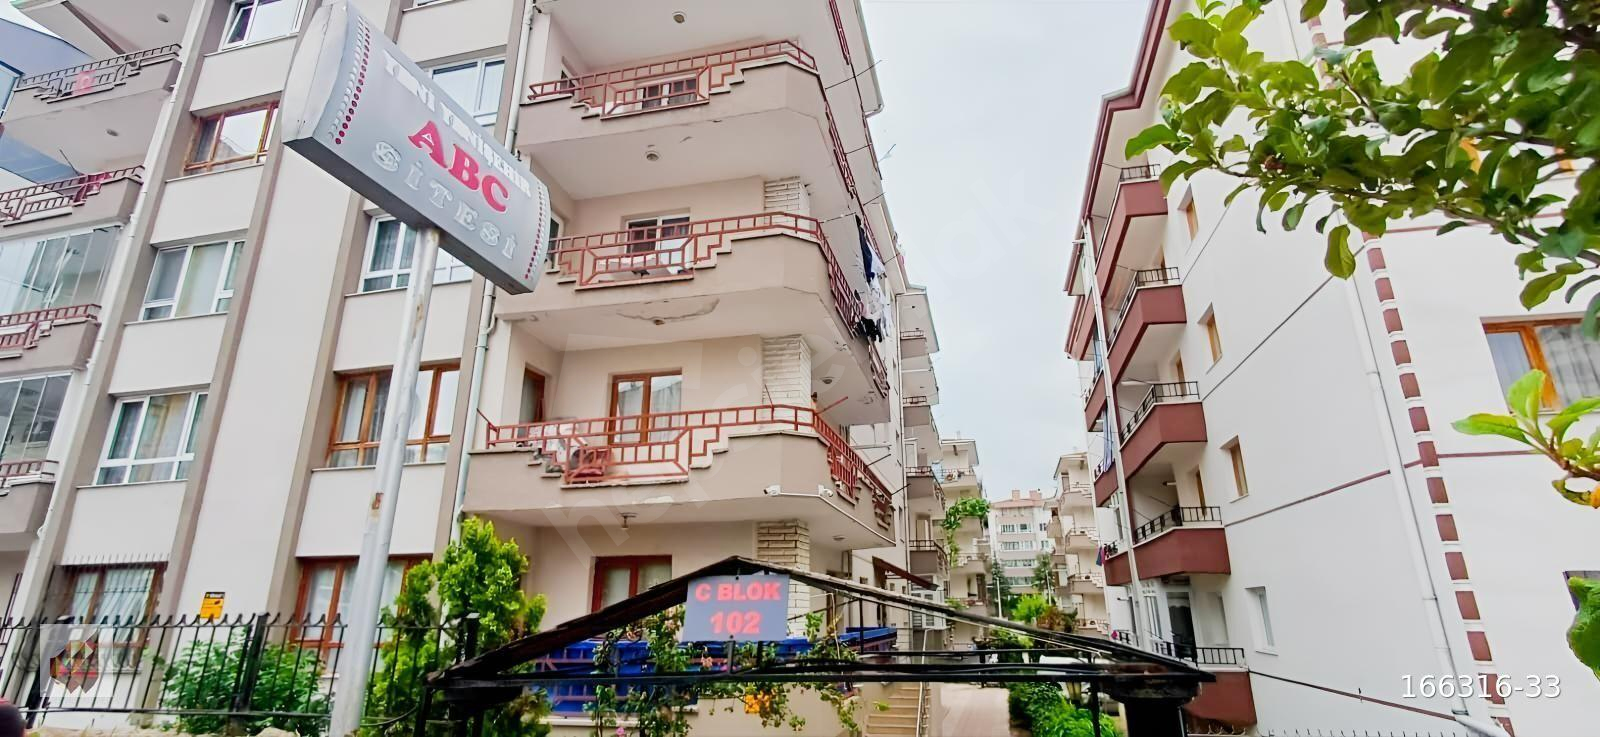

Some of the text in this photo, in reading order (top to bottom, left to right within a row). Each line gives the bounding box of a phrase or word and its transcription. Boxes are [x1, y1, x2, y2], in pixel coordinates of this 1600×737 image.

[408, 120, 509, 213] ABC
[372, 141, 517, 260] SİTESİ
[695, 580, 782, 602] C BLOK
[710, 611, 762, 634] 102
